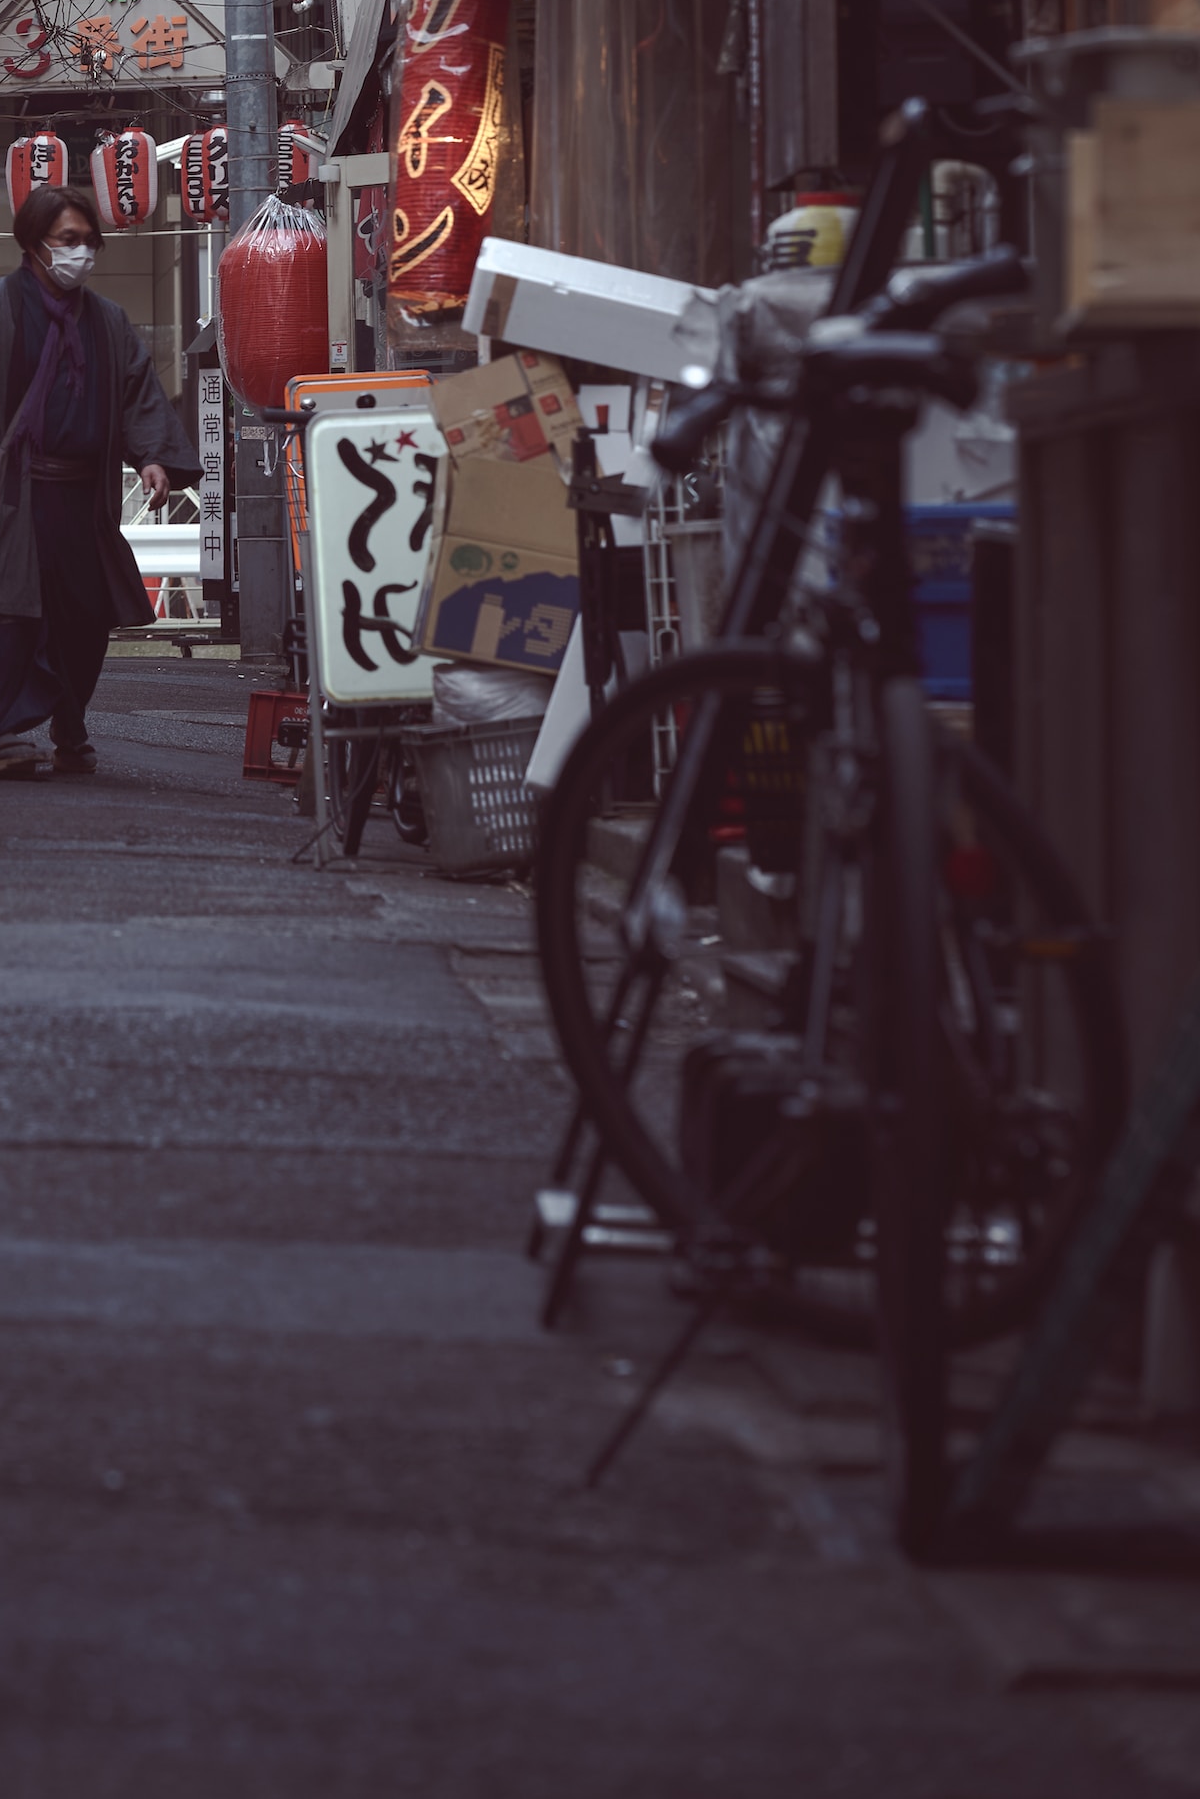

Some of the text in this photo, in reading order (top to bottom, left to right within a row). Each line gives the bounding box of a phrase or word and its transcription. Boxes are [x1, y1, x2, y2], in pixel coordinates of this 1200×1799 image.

[30, 143, 56, 186] ほし
[115, 139, 139, 216] おかえり
[207, 136, 230, 211] クリス
[202, 375, 222, 561] 通常営業中
